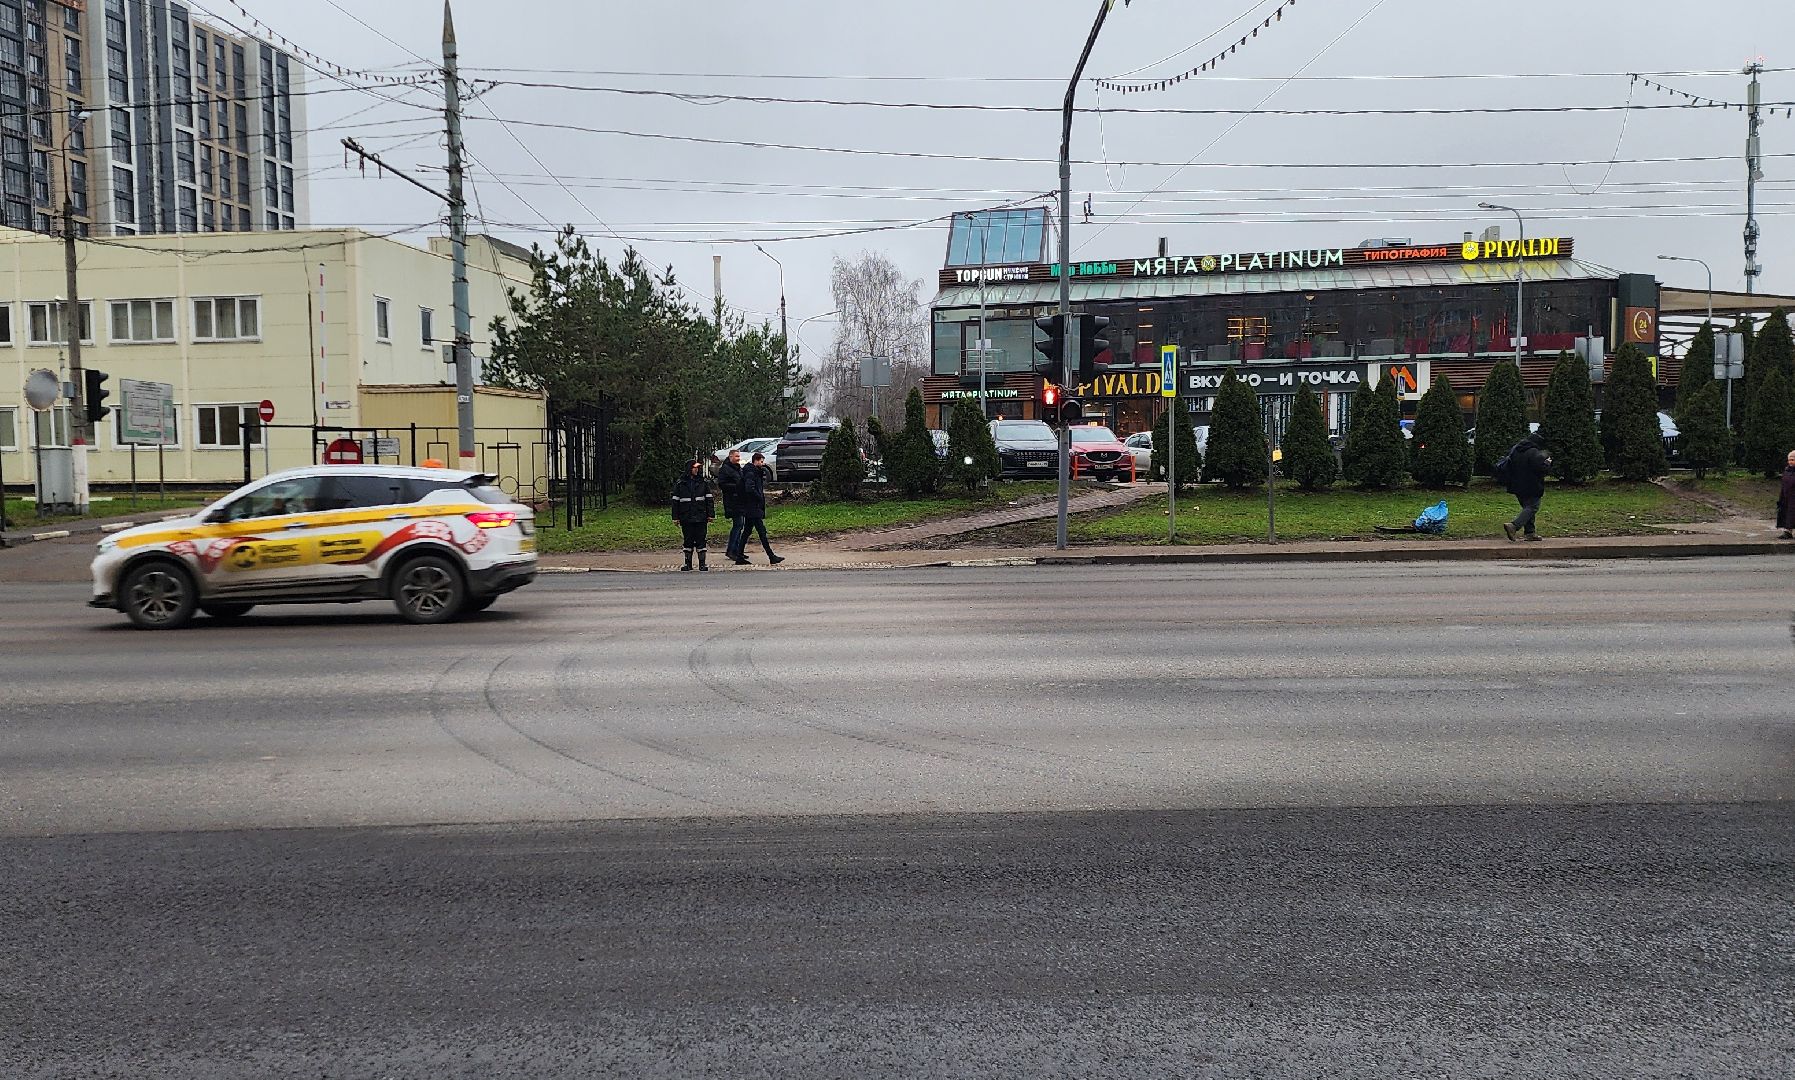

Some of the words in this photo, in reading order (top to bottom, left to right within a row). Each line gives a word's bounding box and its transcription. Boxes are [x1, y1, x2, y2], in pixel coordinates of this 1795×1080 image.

[1364, 247, 1447, 260] ТИПОГРАФИЯ
[1484, 238, 1560, 258] PIVALDI
[1133, 256, 1199, 276] МЯТА
[1220, 249, 1344, 272] PLATINUM
[956, 267, 1003, 283] TOPGUN
[1050, 263, 1076, 277] Мр
[1077, 373, 1161, 396] PIVALD
[1189, 373, 1262, 388] ВКУНО
[1297, 370, 1360, 385] ТОЧКА
[941, 391, 967, 399] МЯТА
[972, 389, 1018, 399] PLATINUM
